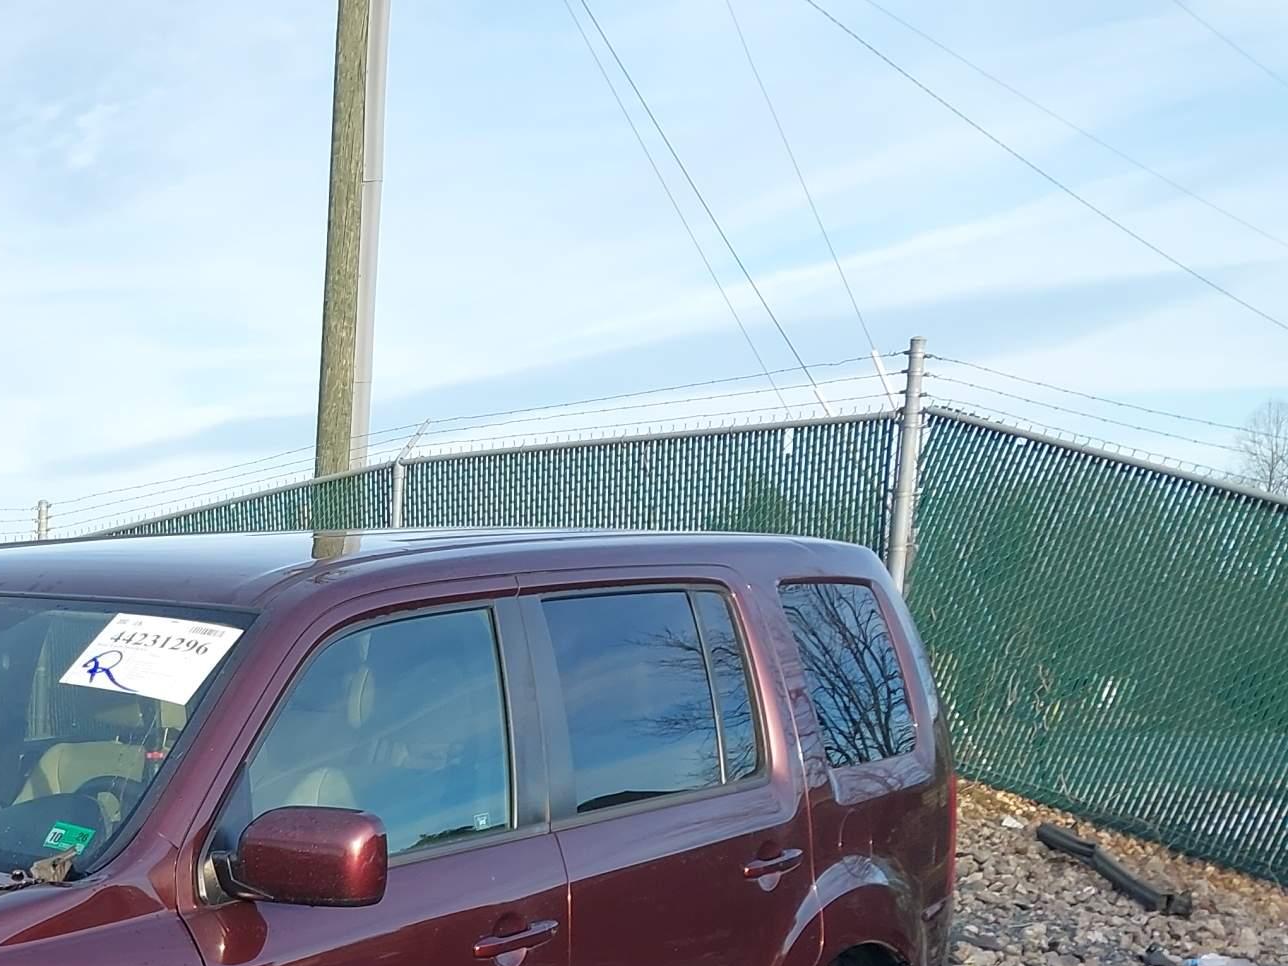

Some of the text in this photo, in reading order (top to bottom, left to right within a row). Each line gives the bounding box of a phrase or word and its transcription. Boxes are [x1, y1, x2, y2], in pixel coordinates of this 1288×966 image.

[110, 630, 210, 655] 44231296
[82, 650, 140, 692] R
[49, 831, 63, 843] 10
